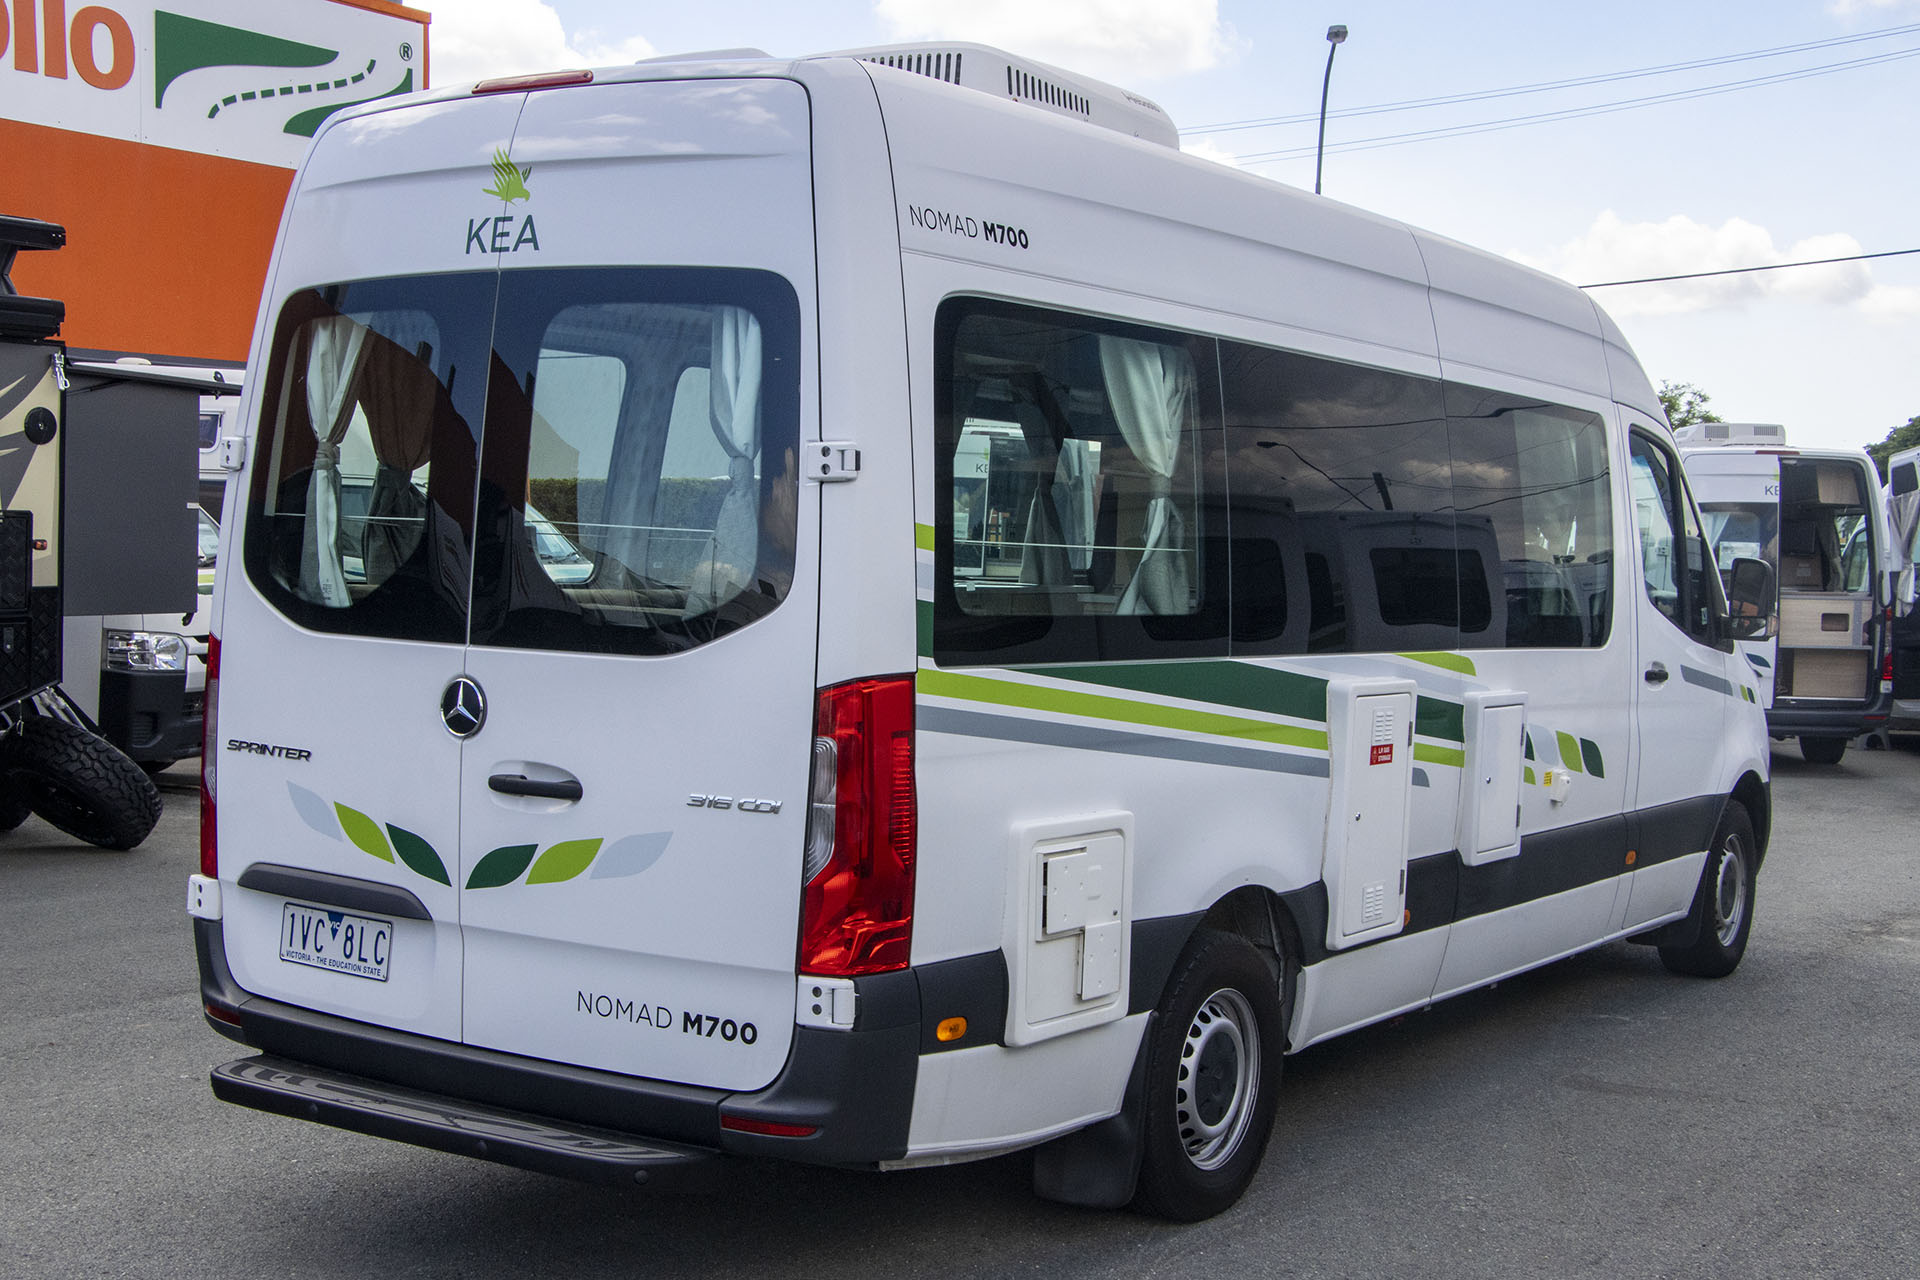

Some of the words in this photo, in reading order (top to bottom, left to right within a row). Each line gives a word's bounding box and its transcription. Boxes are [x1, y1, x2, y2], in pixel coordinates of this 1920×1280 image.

[0, 0, 135, 90] llo
[465, 215, 540, 254] KEA
[909, 205, 978, 238] NOMAD
[983, 221, 1029, 249] M700
[227, 739, 312, 762] SPRINTER
[686, 794, 734, 810] 316
[737, 798, 783, 814] CDI
[289, 912, 326, 953] 1VC
[343, 924, 387, 966] 8LC
[286, 949, 312, 962] VICTORIA
[316, 955, 328, 966] THE
[328, 958, 362, 973] EDUCATION
[363, 966, 382, 977] STATE
[577, 990, 673, 1029] NOMAD
[682, 1011, 758, 1045] M700
